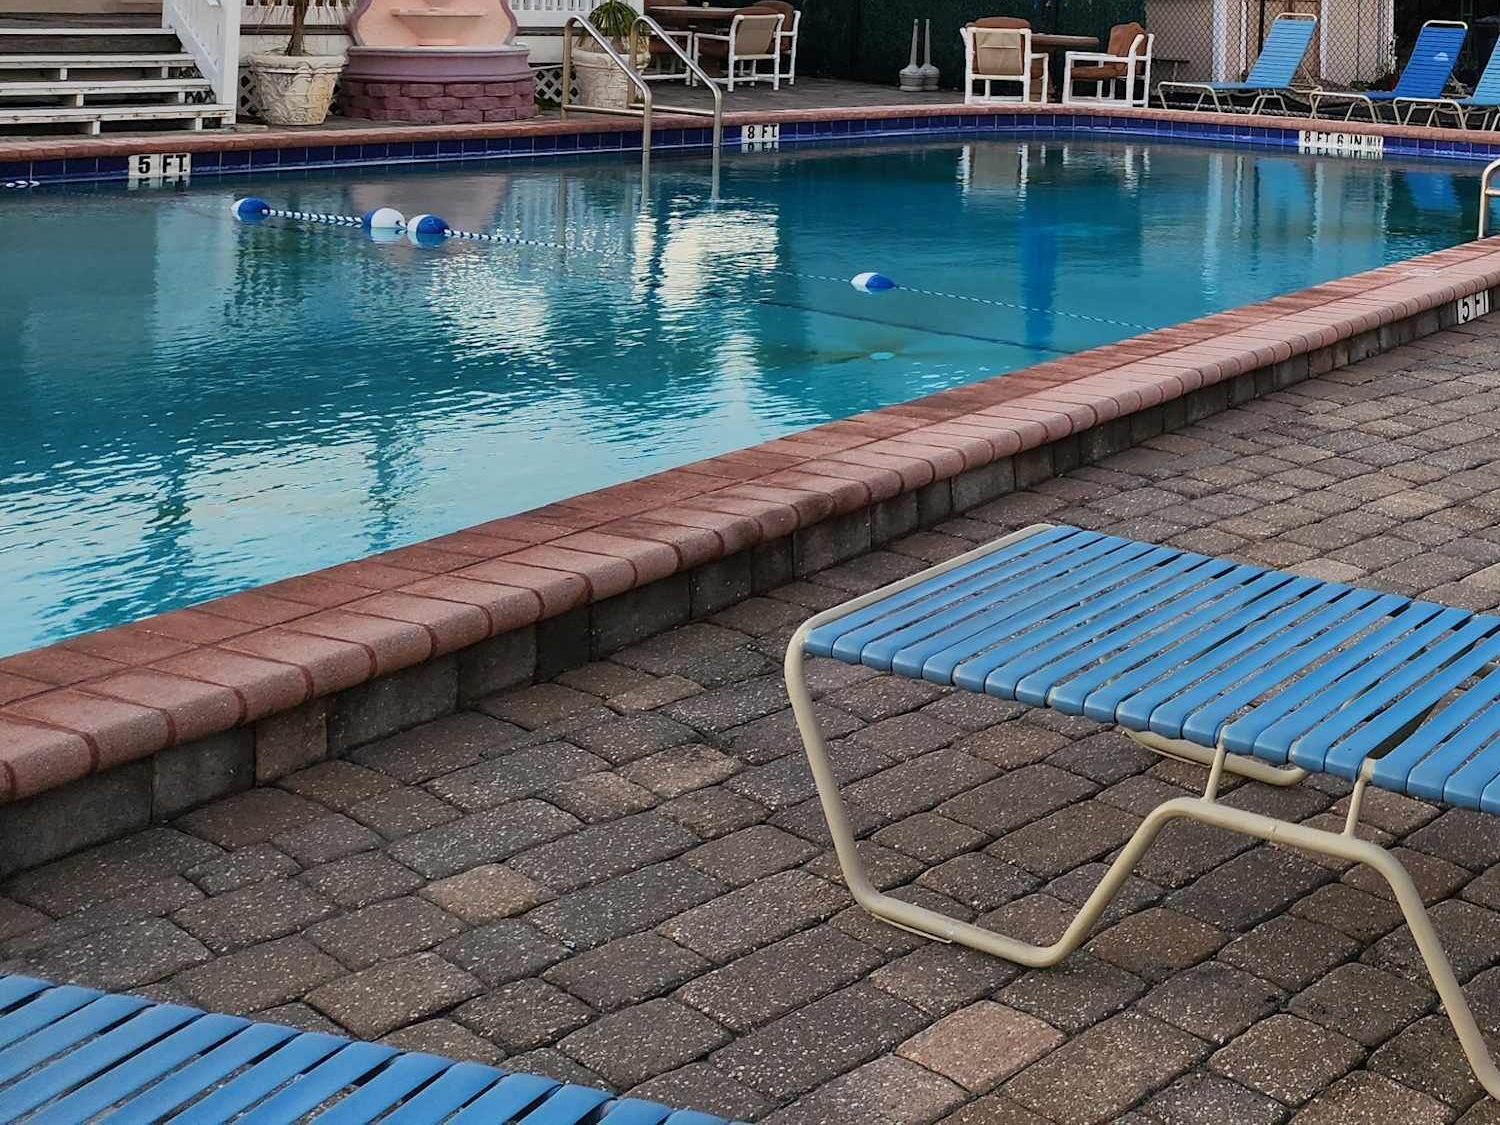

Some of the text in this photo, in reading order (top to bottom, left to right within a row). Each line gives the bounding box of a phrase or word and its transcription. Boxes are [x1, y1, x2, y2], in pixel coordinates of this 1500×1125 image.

[747, 125, 755, 139] 8
[1350, 135, 1362, 146] IN
[138, 155, 152, 174] 5
[1462, 298, 1470, 322] 5
